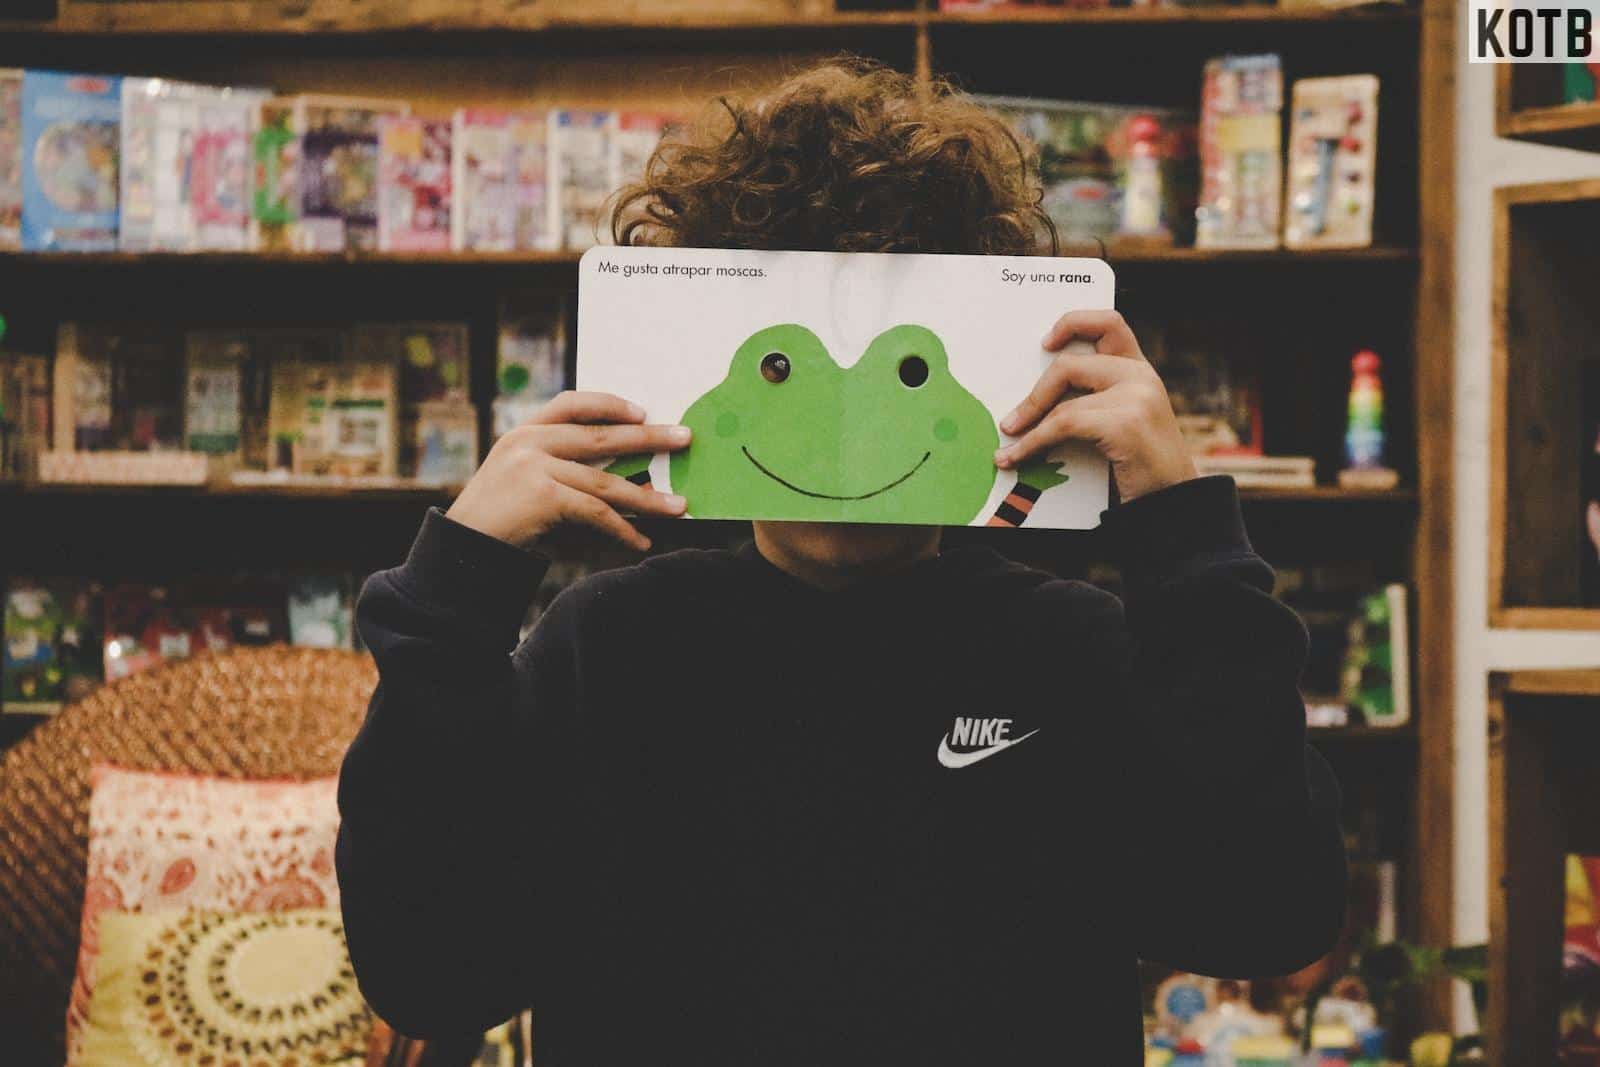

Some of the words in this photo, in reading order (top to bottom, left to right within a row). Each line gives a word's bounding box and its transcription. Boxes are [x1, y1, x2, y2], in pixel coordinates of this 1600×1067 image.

[598, 261, 619, 273] Me
[623, 263, 658, 277] gusta
[662, 264, 712, 279] atrapar
[716, 267, 768, 277] moscas.
[1001, 268, 1026, 286] Soy
[1030, 273, 1055, 283] una
[1059, 273, 1095, 284] rana.
[951, 717, 1013, 746] NIKE
